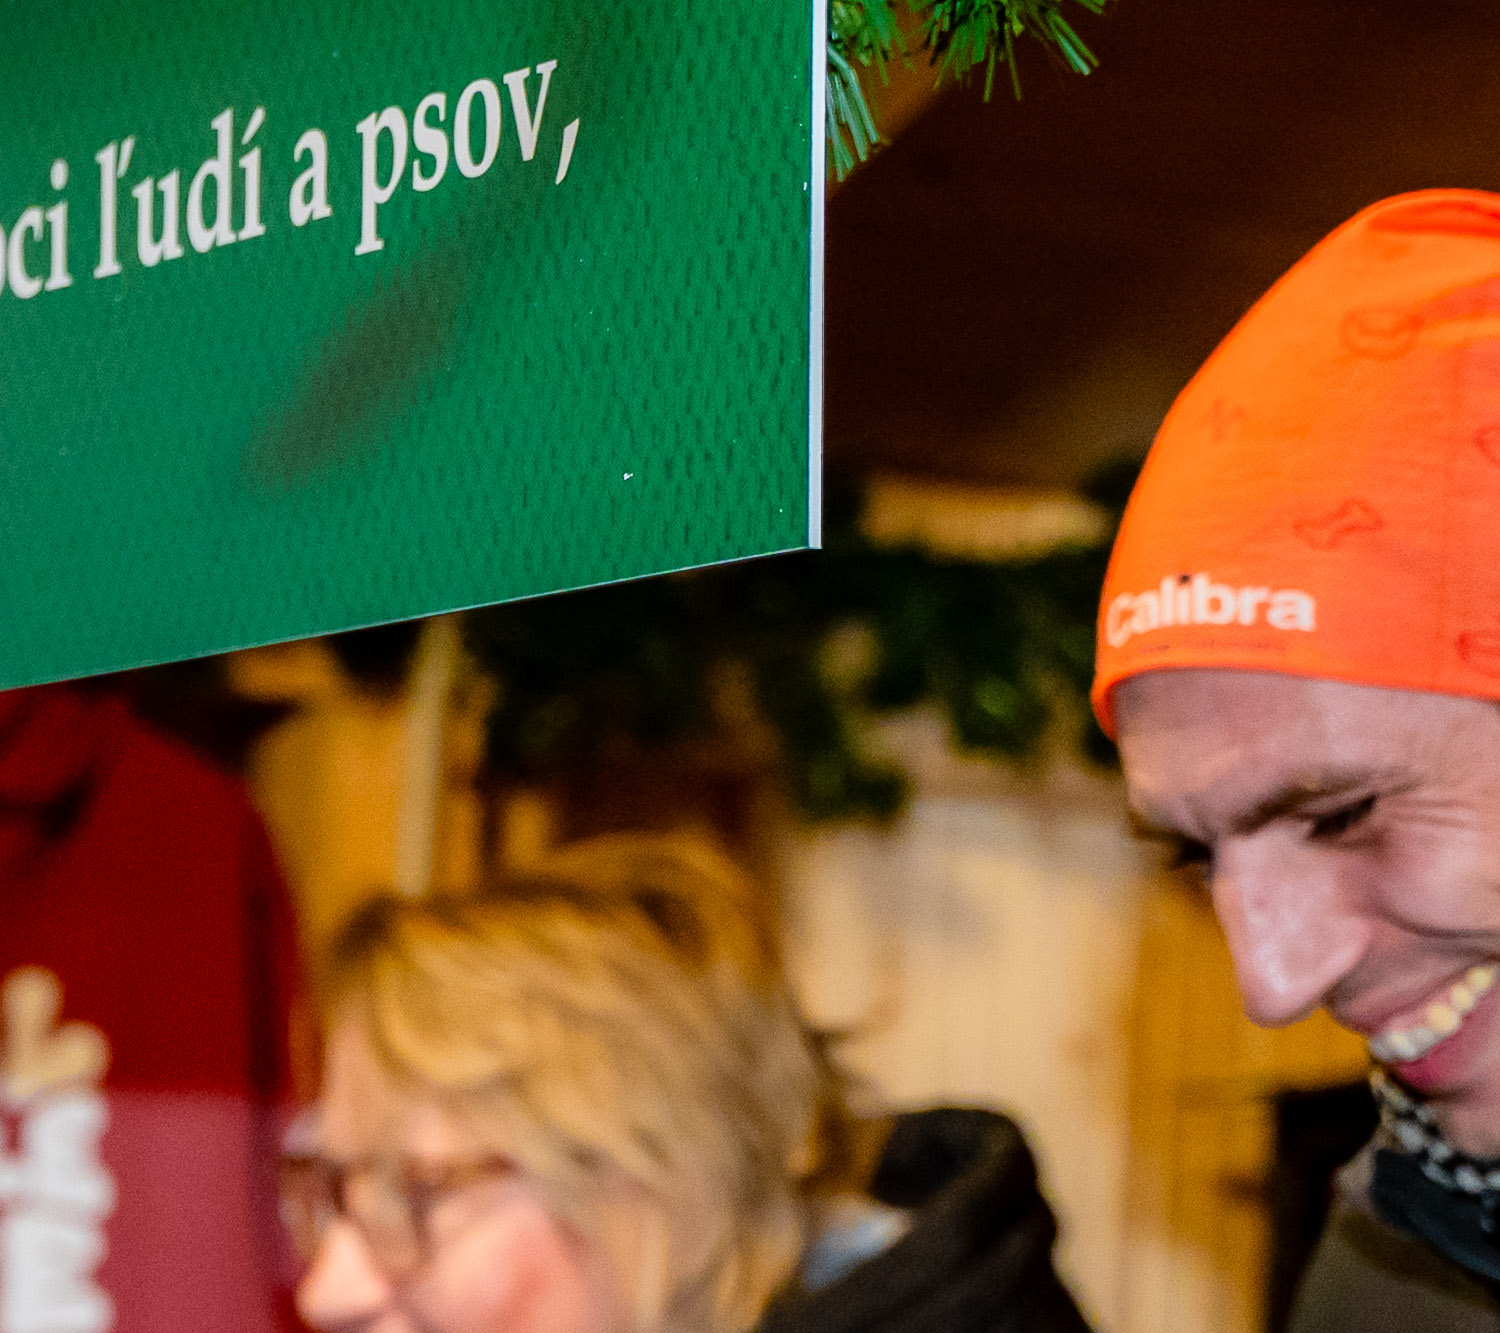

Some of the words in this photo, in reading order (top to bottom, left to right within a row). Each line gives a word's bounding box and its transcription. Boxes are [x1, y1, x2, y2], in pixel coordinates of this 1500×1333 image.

[94, 107, 267, 279] ľudí
[288, 127, 332, 227] a
[354, 59, 581, 256] psov,
[1106, 572, 1317, 648] calibra
